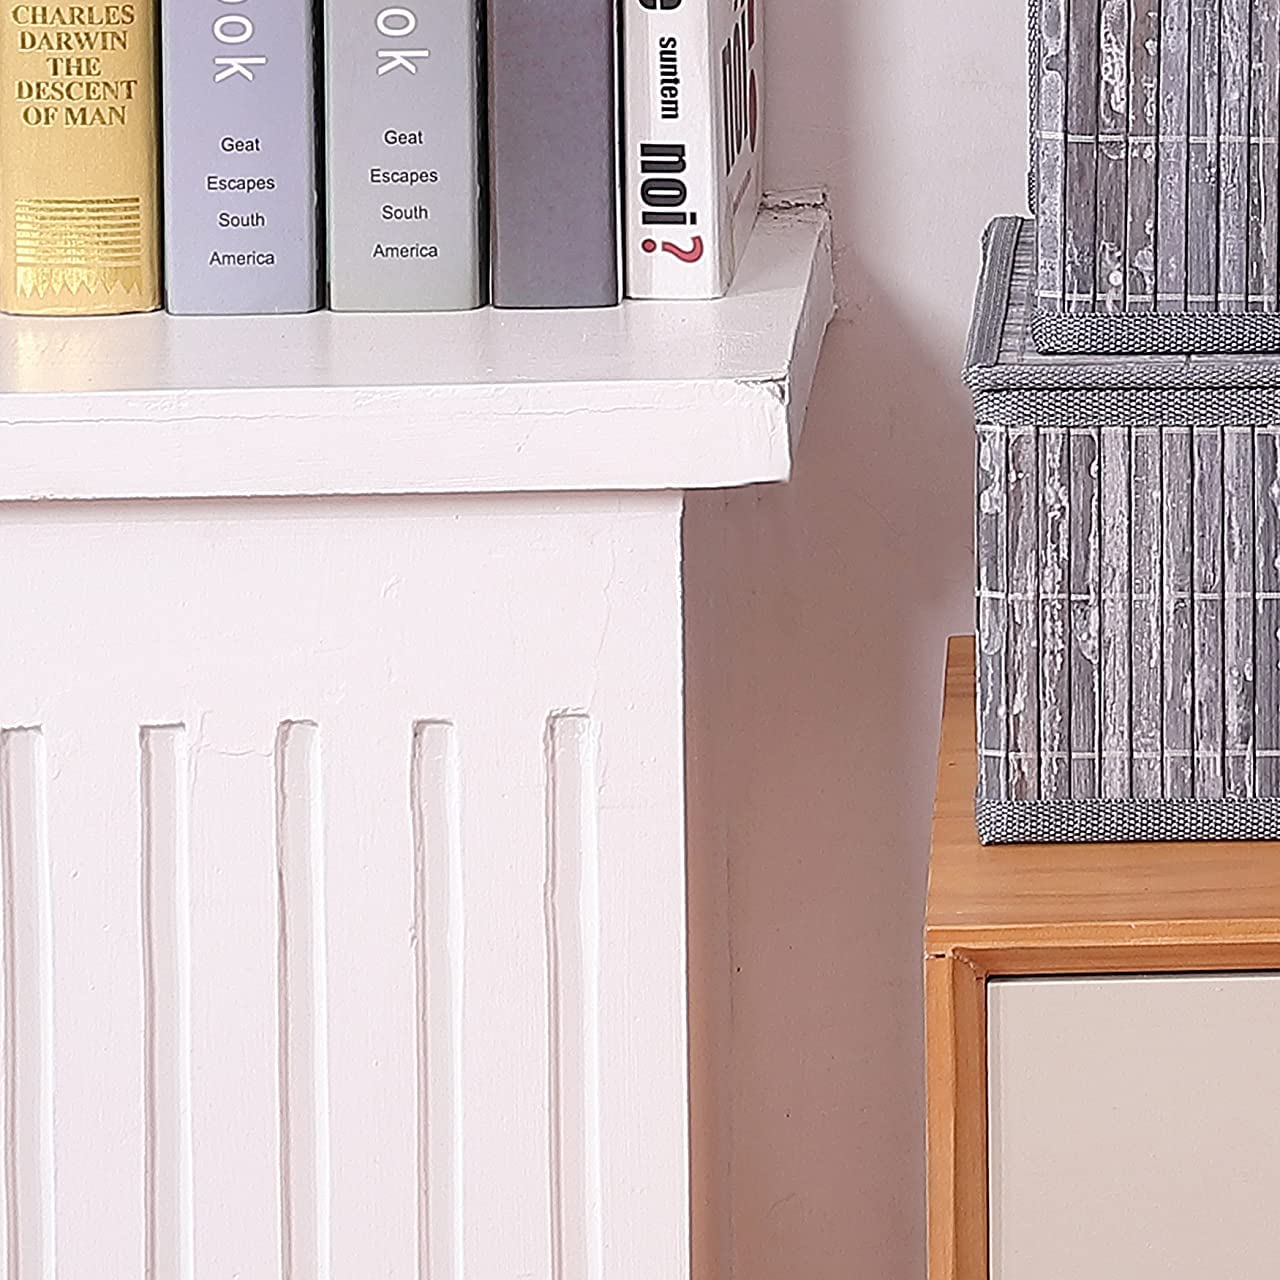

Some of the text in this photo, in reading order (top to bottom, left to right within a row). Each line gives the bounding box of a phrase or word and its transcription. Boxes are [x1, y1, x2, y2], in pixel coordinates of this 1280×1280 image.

[12, 5, 135, 25] CHARLES
[19, 30, 128, 50] DARWIN
[46, 57, 101, 76] THE
[659, 36, 680, 119] suntem
[17, 80, 138, 101] DESCENT
[22, 105, 126, 126] OF MAN
[221, 137, 260, 152] Geat
[384, 130, 424, 145] Geat
[207, 176, 276, 193] Escapes
[369, 168, 438, 185] Escapes
[640, 143, 704, 264] noi?
[218, 212, 265, 227] South
[382, 205, 429, 220] South
[209, 251, 275, 266] America
[373, 244, 438, 258] America
